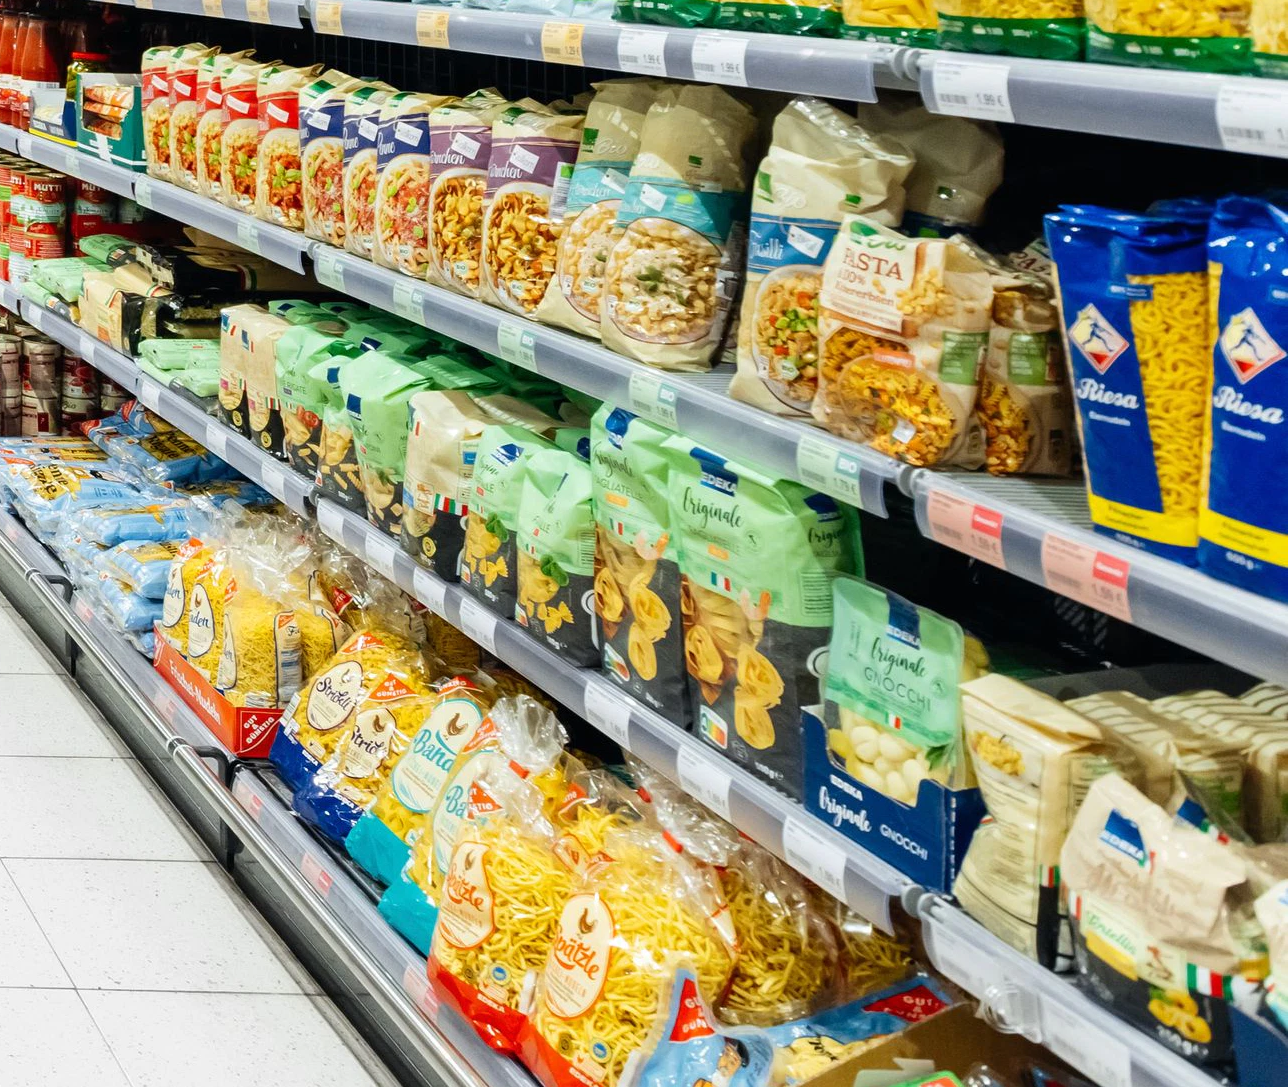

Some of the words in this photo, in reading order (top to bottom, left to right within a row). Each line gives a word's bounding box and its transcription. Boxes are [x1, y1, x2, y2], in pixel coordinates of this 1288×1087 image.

[33, 183, 63, 192] MUTTI
[843, 248, 903, 281] PASTA
[1076, 378, 1139, 409] Riesa
[1213, 386, 1284, 424] Riesa
[838, 461, 857, 474] BIO
[701, 473, 738, 495] EDEKA
[683, 487, 743, 528] Originale
[871, 637, 927, 678] Originale
[377, 689, 407, 697] GÜNSTIG
[864, 666, 931, 713] GNOCCHI
[242, 715, 259, 731] GUT
[245, 716, 275, 745] GÜNSTIG
[830, 775, 863, 801] EDEKA
[818, 786, 872, 834] Originale
[880, 824, 928, 860] GNOCCHI
[554, 924, 600, 981] Spätzle
